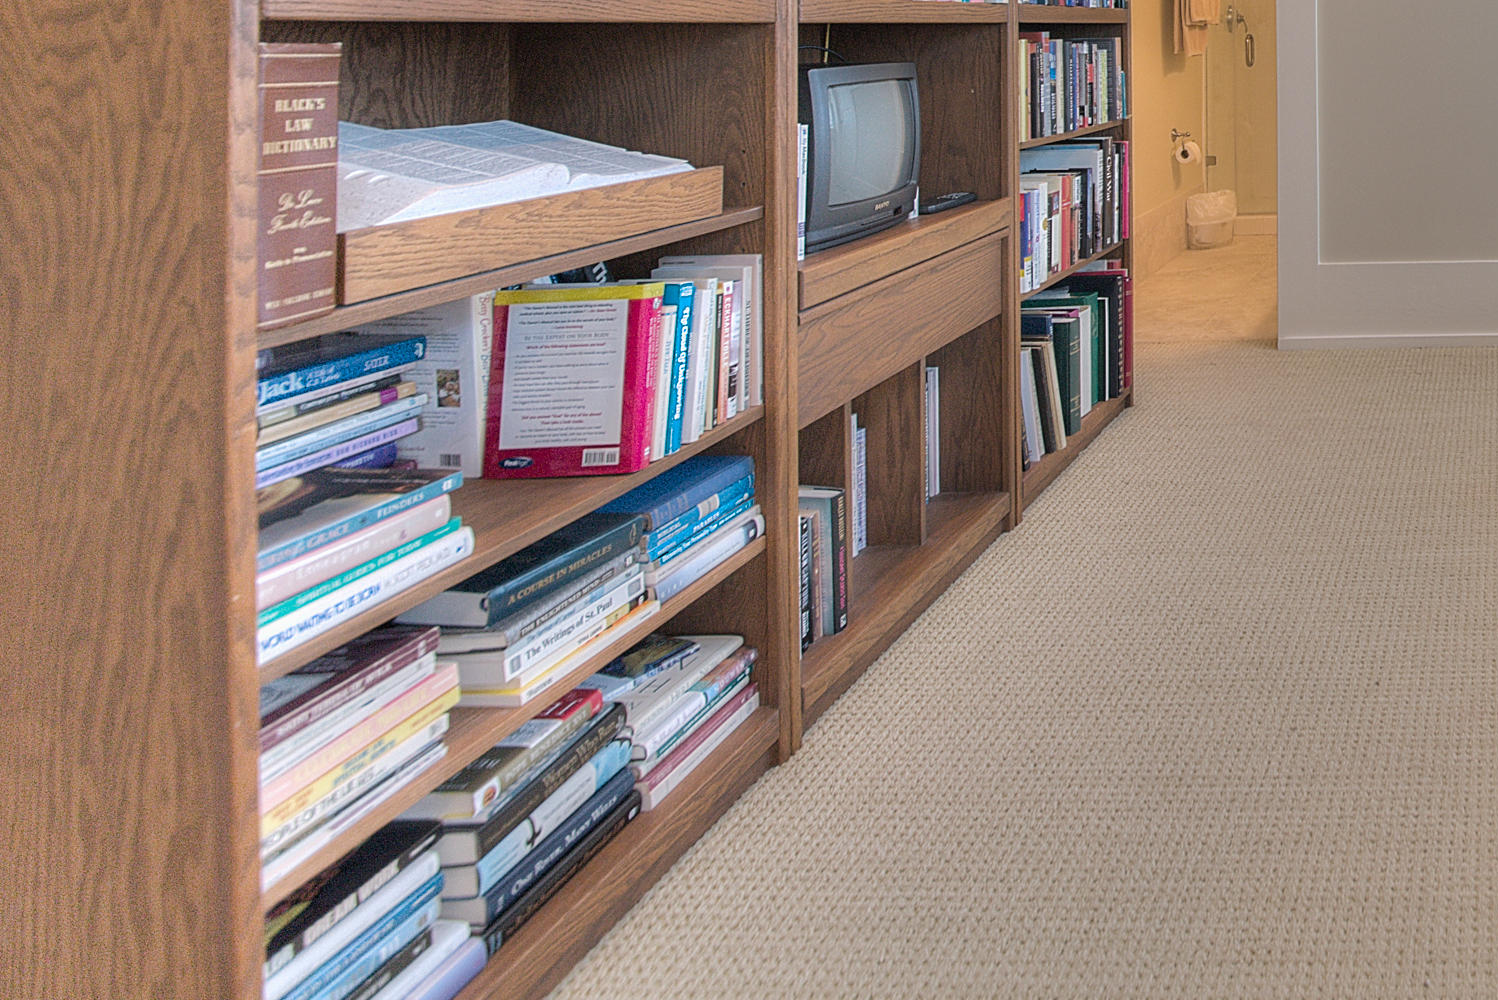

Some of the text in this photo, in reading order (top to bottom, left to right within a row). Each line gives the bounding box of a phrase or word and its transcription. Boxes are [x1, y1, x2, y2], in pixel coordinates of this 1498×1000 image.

[275, 97, 326, 113] BLACK'S
[285, 118, 313, 133] LAW
[262, 136, 338, 155] DICTIONARY
[875, 201, 890, 211] SANYO
[478, 293, 490, 352] Betty Crocker's
[720, 296, 733, 366] ECKHART TOLLE
[672, 306, 692, 419] The Cloud Of Unknowing
[258, 371, 306, 406] Jack
[307, 492, 426, 550] GRACE FLINDERS
[378, 552, 396, 569] FOR
[397, 539, 424, 559] TODAY
[508, 544, 613, 605] A COURSE IN MIRACLES
[260, 626, 296, 652] WORLD
[525, 598, 613, 660] The Writings of St. Paul
[512, 872, 534, 894] One
[565, 822, 592, 851] Many
